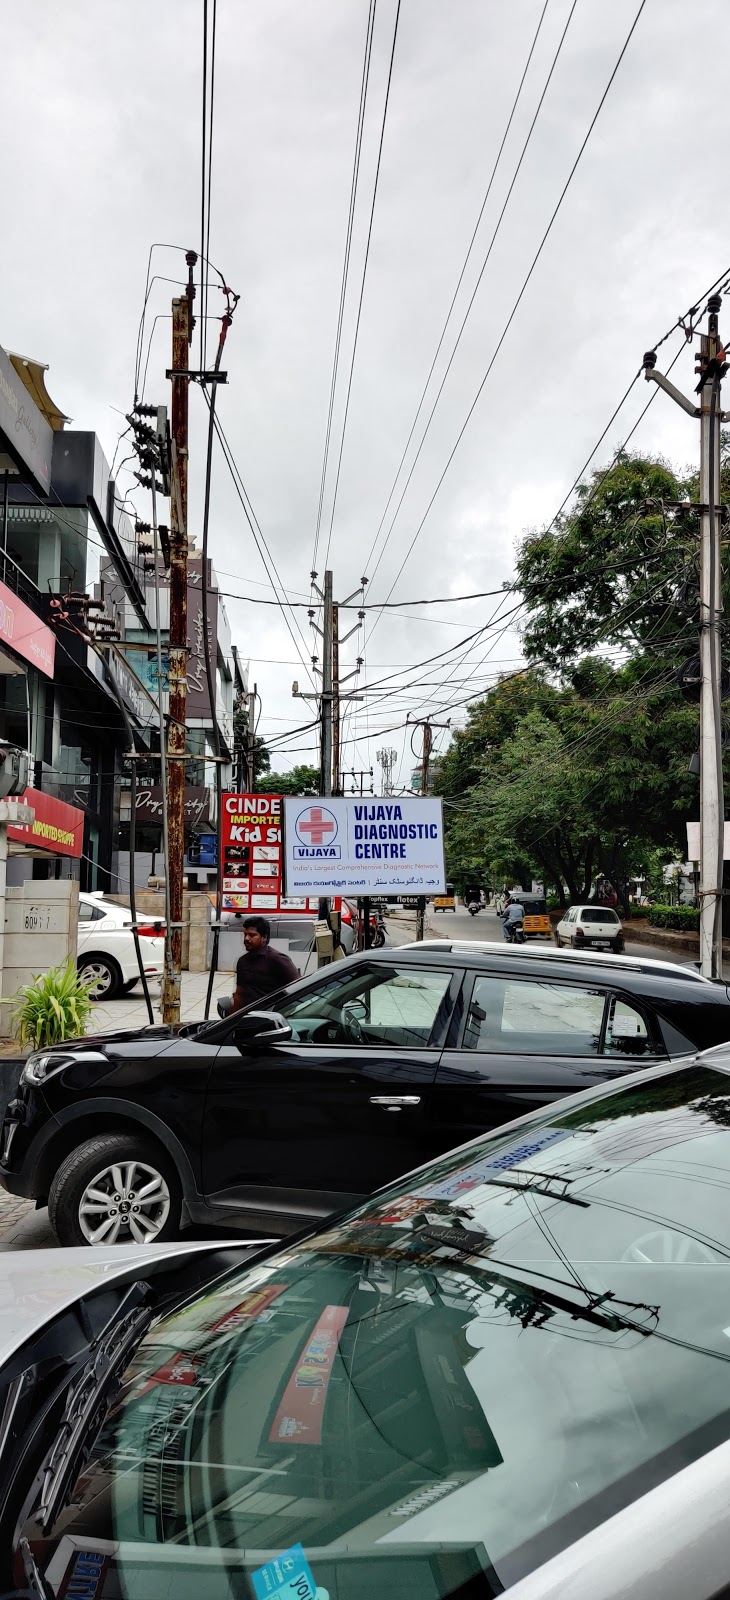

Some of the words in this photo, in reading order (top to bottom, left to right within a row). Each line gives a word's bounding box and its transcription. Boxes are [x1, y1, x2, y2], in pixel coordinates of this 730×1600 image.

[230, 816, 280, 824] IMPORTE
[354, 806, 402, 820] VIJAYA
[230, 826, 262, 842] Kid
[354, 824, 438, 840] DIAGNOSTIC
[298, 848, 336, 856] VIJAYA
[354, 844, 407, 859] CENTRE
